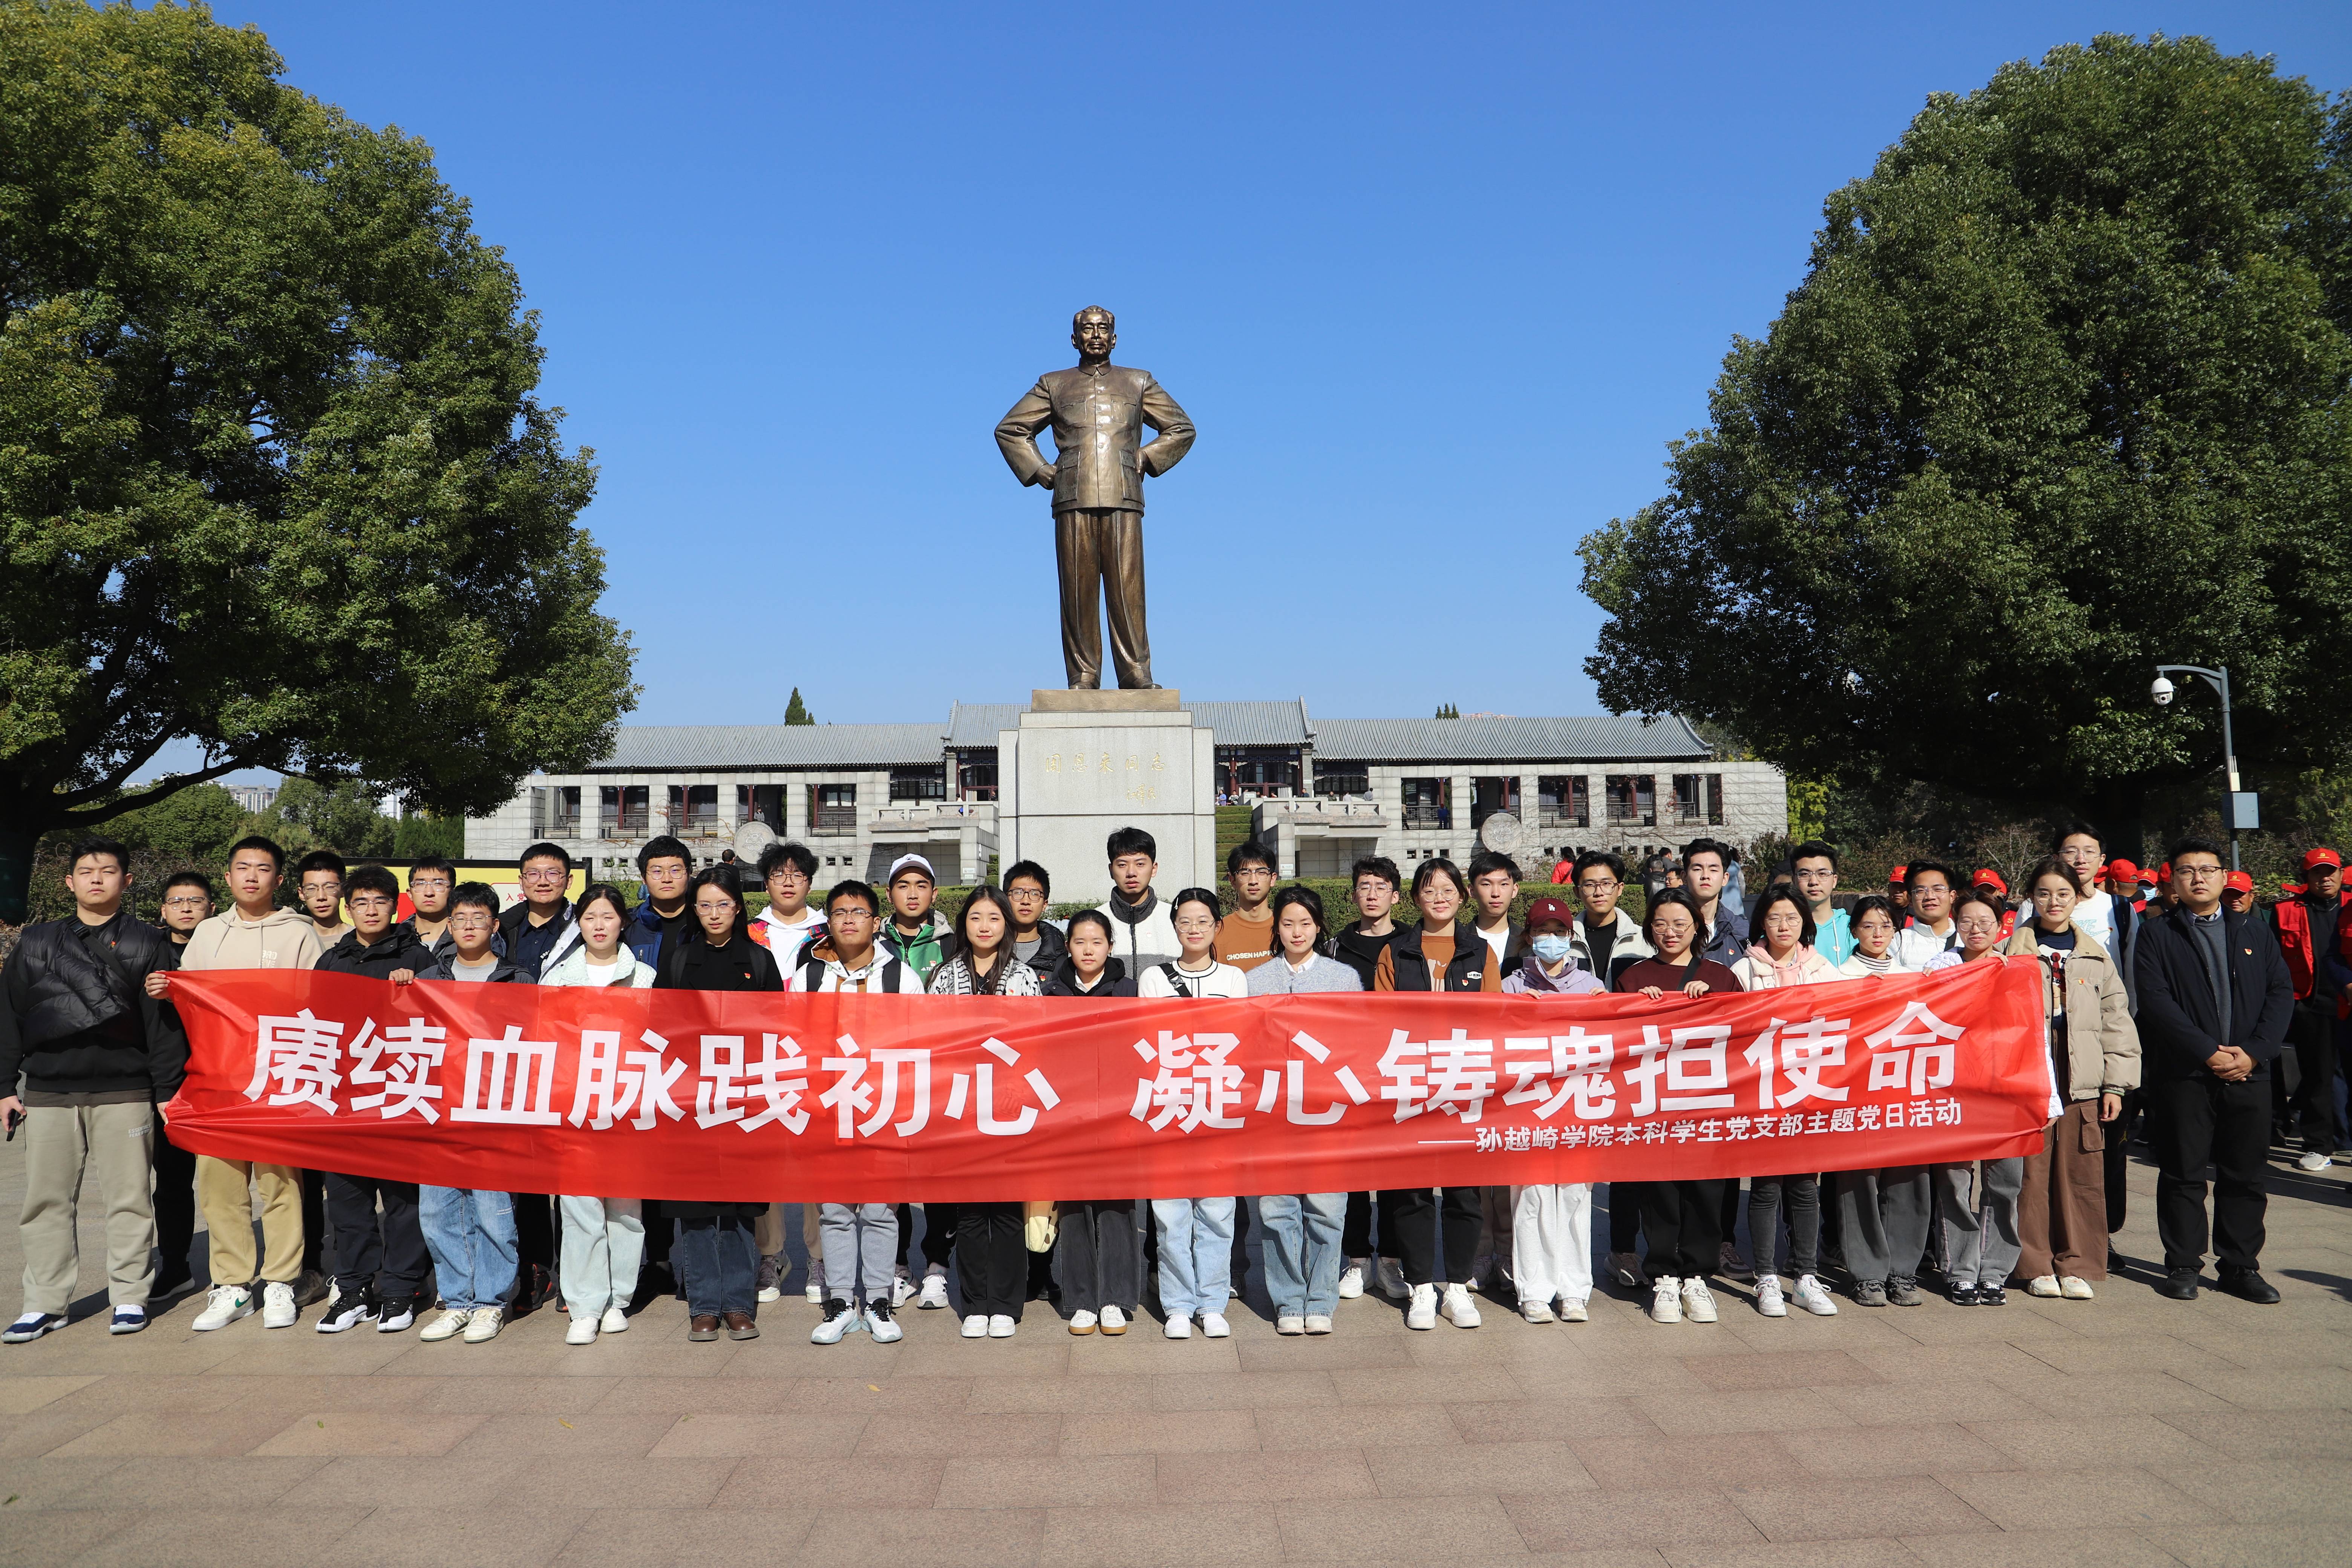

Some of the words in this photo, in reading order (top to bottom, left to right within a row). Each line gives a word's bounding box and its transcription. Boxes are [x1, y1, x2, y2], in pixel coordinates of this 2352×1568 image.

[1046, 752, 1165, 774] 周恩来同志
[1227, 952, 1253, 961] CHOSEN
[242, 1008, 1061, 1138] 赓续血脉践初心
[1129, 1001, 1966, 1134] 凝心铸魂担使命
